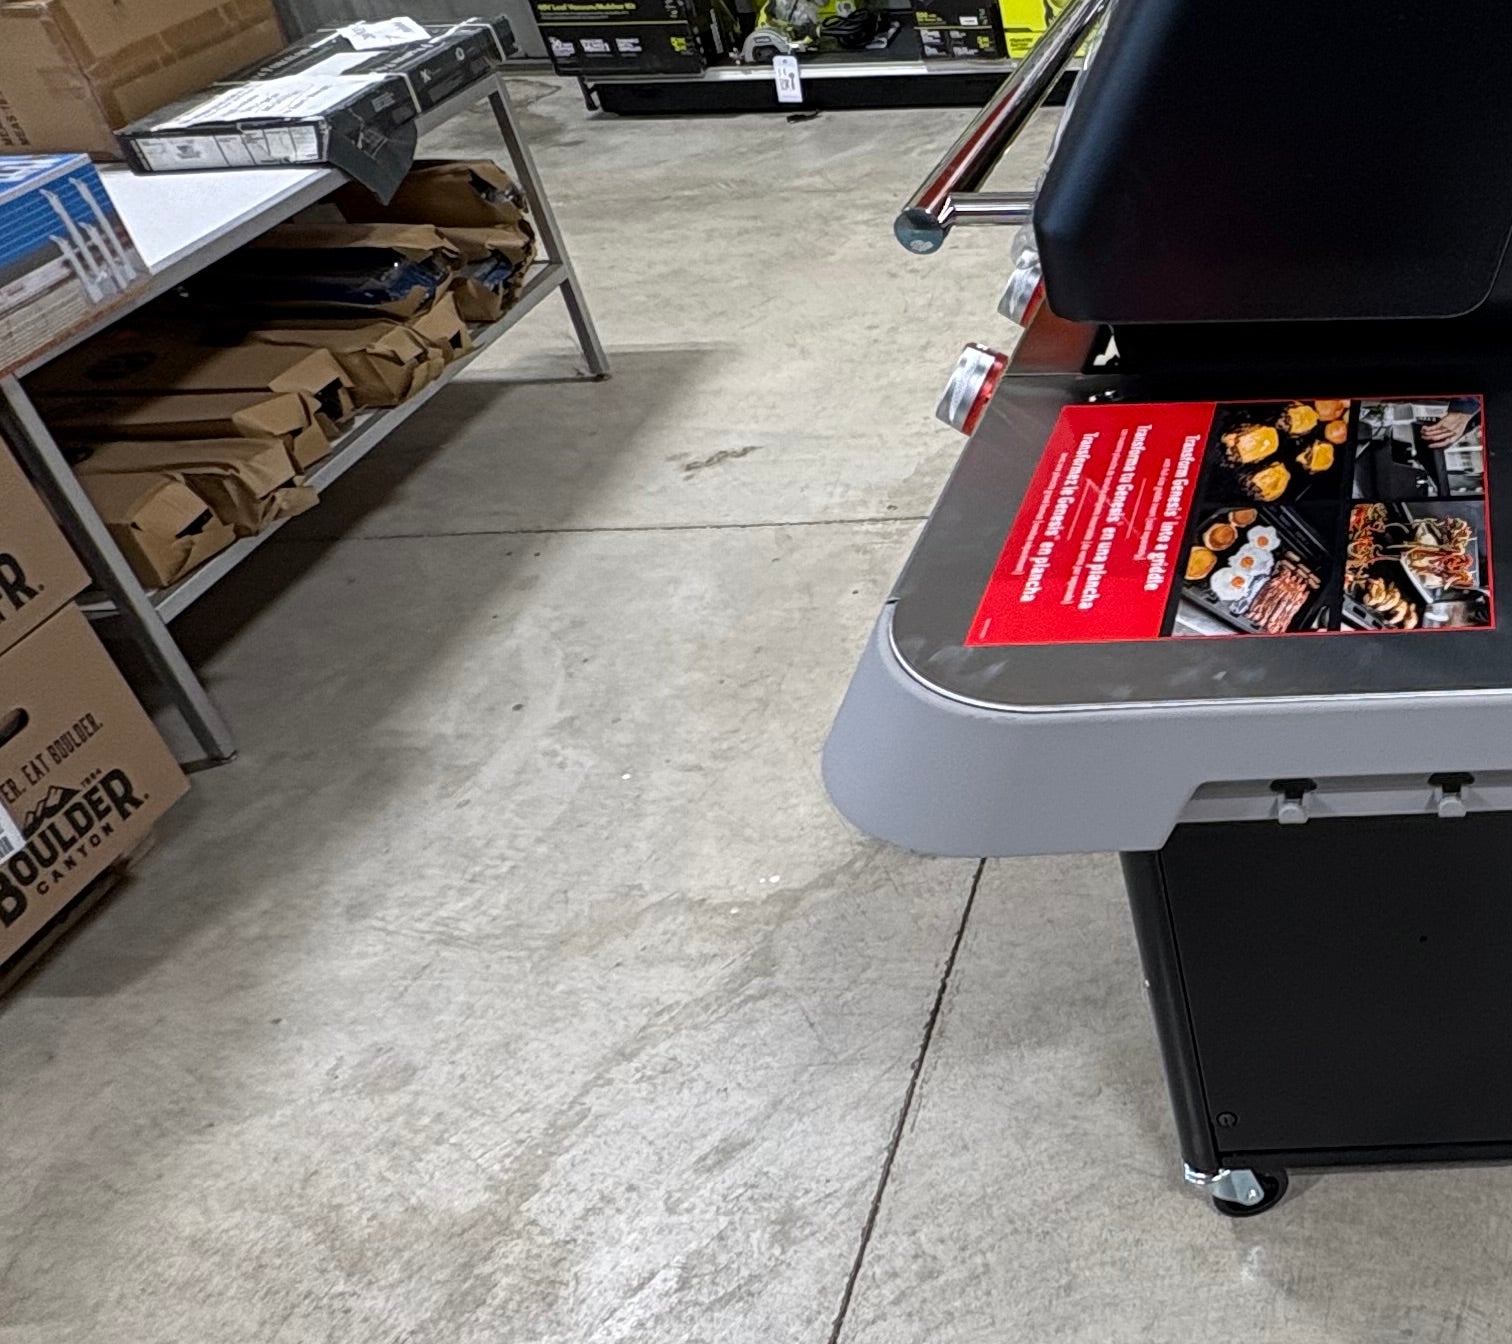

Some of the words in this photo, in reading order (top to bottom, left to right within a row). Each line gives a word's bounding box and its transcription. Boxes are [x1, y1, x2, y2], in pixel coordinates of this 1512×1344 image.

[1062, 432, 1099, 485] Transformez
[1121, 424, 1152, 471] Transforma
[1172, 434, 1201, 477] Transform
[1059, 486, 1078, 495] le
[1117, 472, 1136, 482] tu
[1036, 541, 1054, 555] en
[1092, 541, 1111, 562] una
[1099, 527, 1116, 540] en
[1155, 521, 1178, 542] into
[1013, 556, 1052, 602] plancha
[1071, 563, 1108, 609] plancha
[1139, 551, 1170, 590] griddle
[25, 754, 47, 787] EAT
[47, 712, 104, 762] BOULDER.
[37, 821, 115, 897] CANYON
